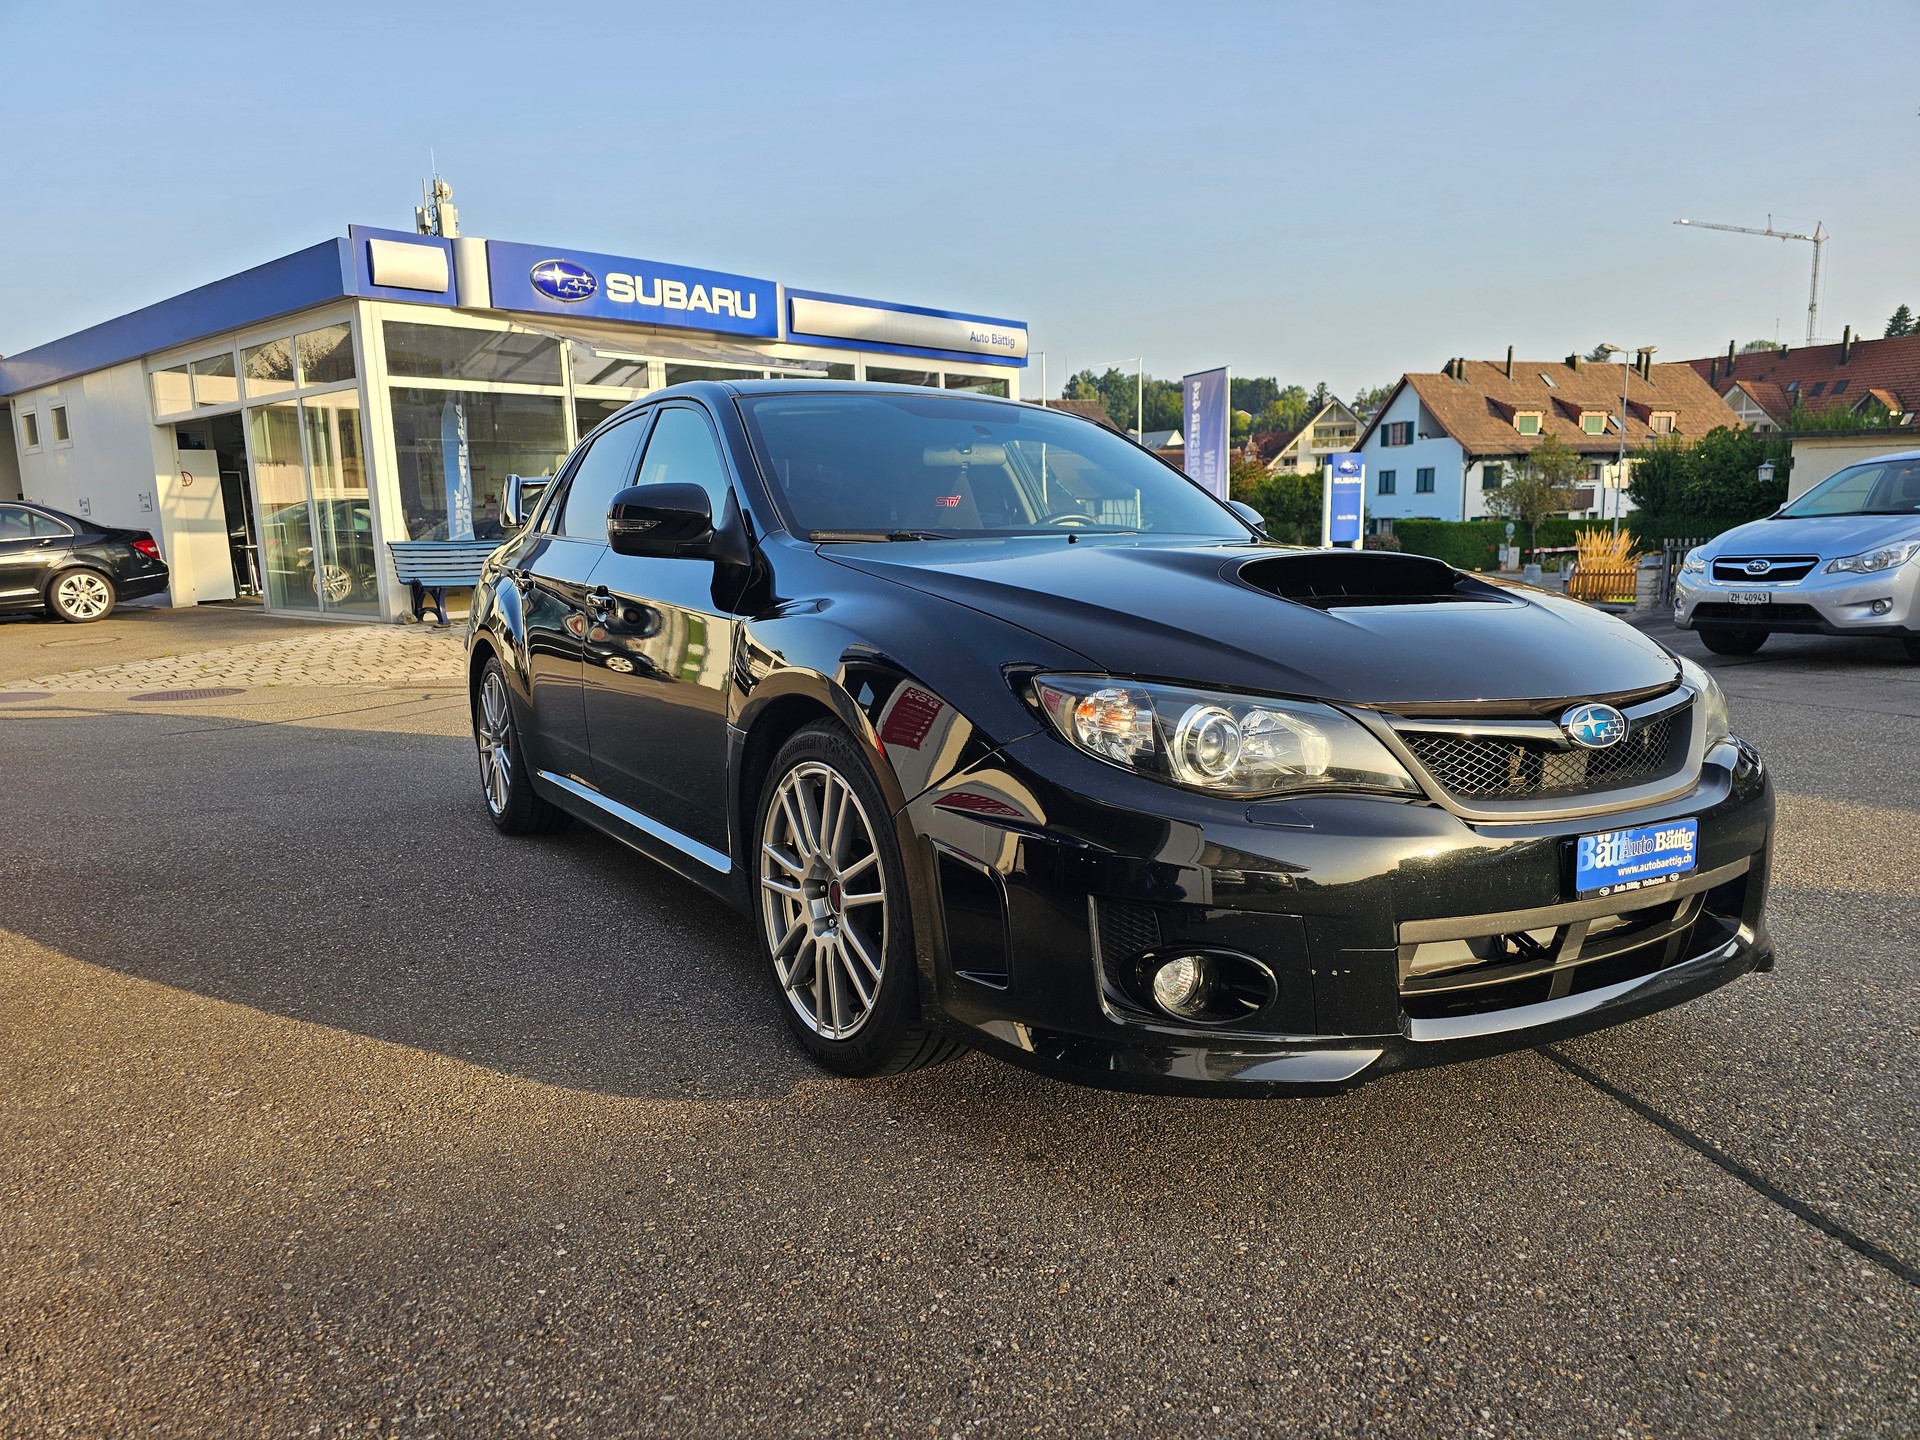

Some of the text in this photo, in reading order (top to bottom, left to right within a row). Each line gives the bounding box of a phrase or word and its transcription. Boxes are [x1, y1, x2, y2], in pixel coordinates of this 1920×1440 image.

[605, 272, 757, 319] SUBARU
[970, 331, 1015, 349] Auto Bättig
[1619, 827, 1695, 859] Auto Bättig
[1617, 853, 1692, 877] www.autobaettig.ch
